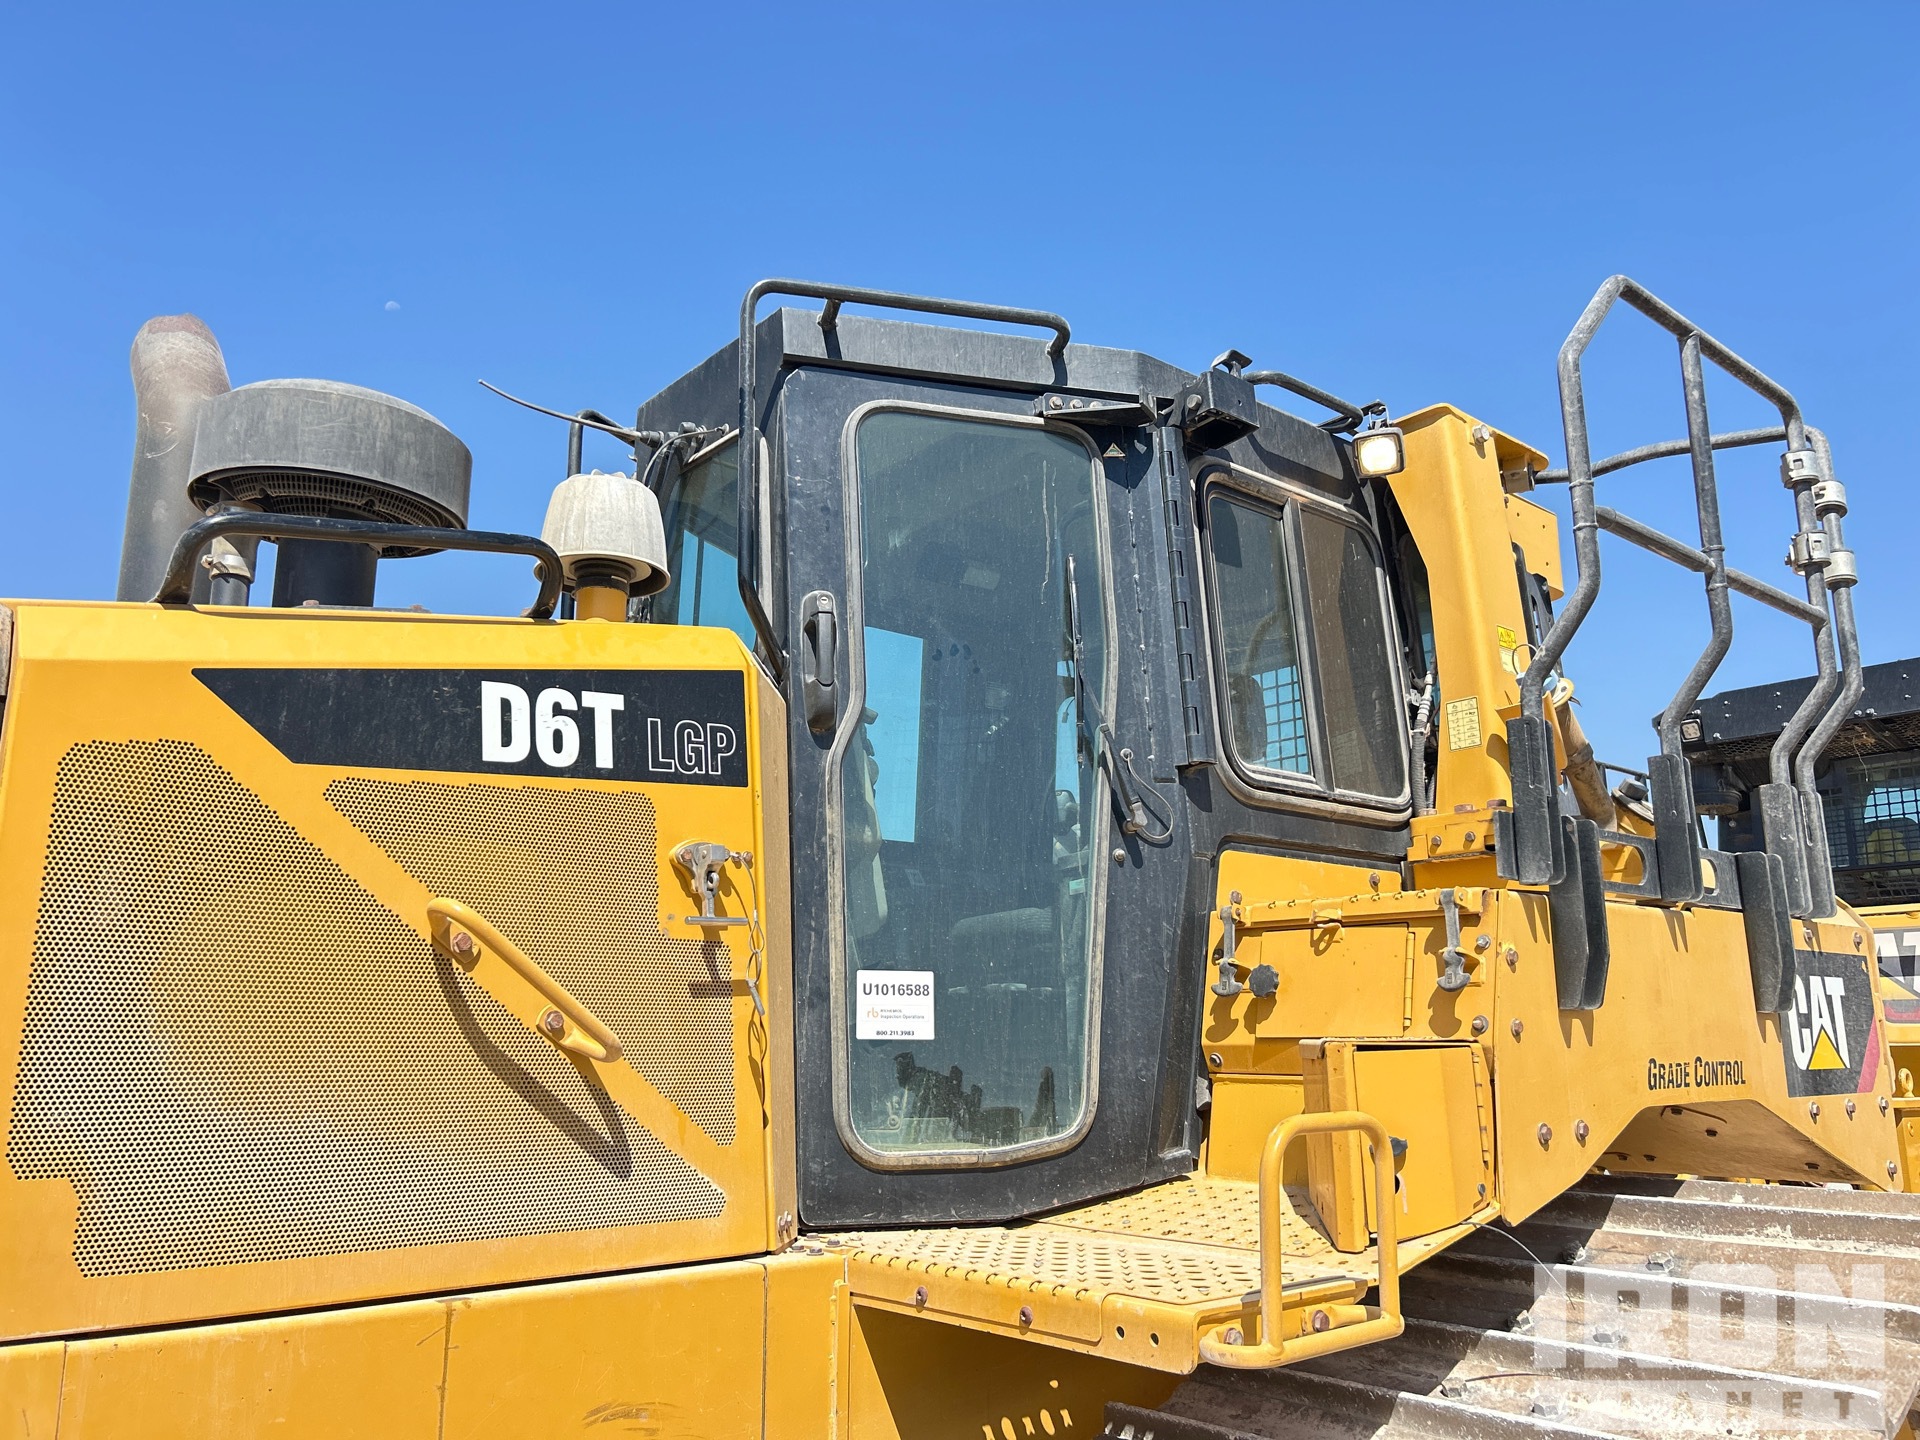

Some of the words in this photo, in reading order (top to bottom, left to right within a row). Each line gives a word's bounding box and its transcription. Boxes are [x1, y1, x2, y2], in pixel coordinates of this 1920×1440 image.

[481, 680, 625, 769] D6T
[647, 717, 737, 775] LGP
[863, 983, 930, 996] U1016588
[1788, 975, 1851, 1071] CAT
